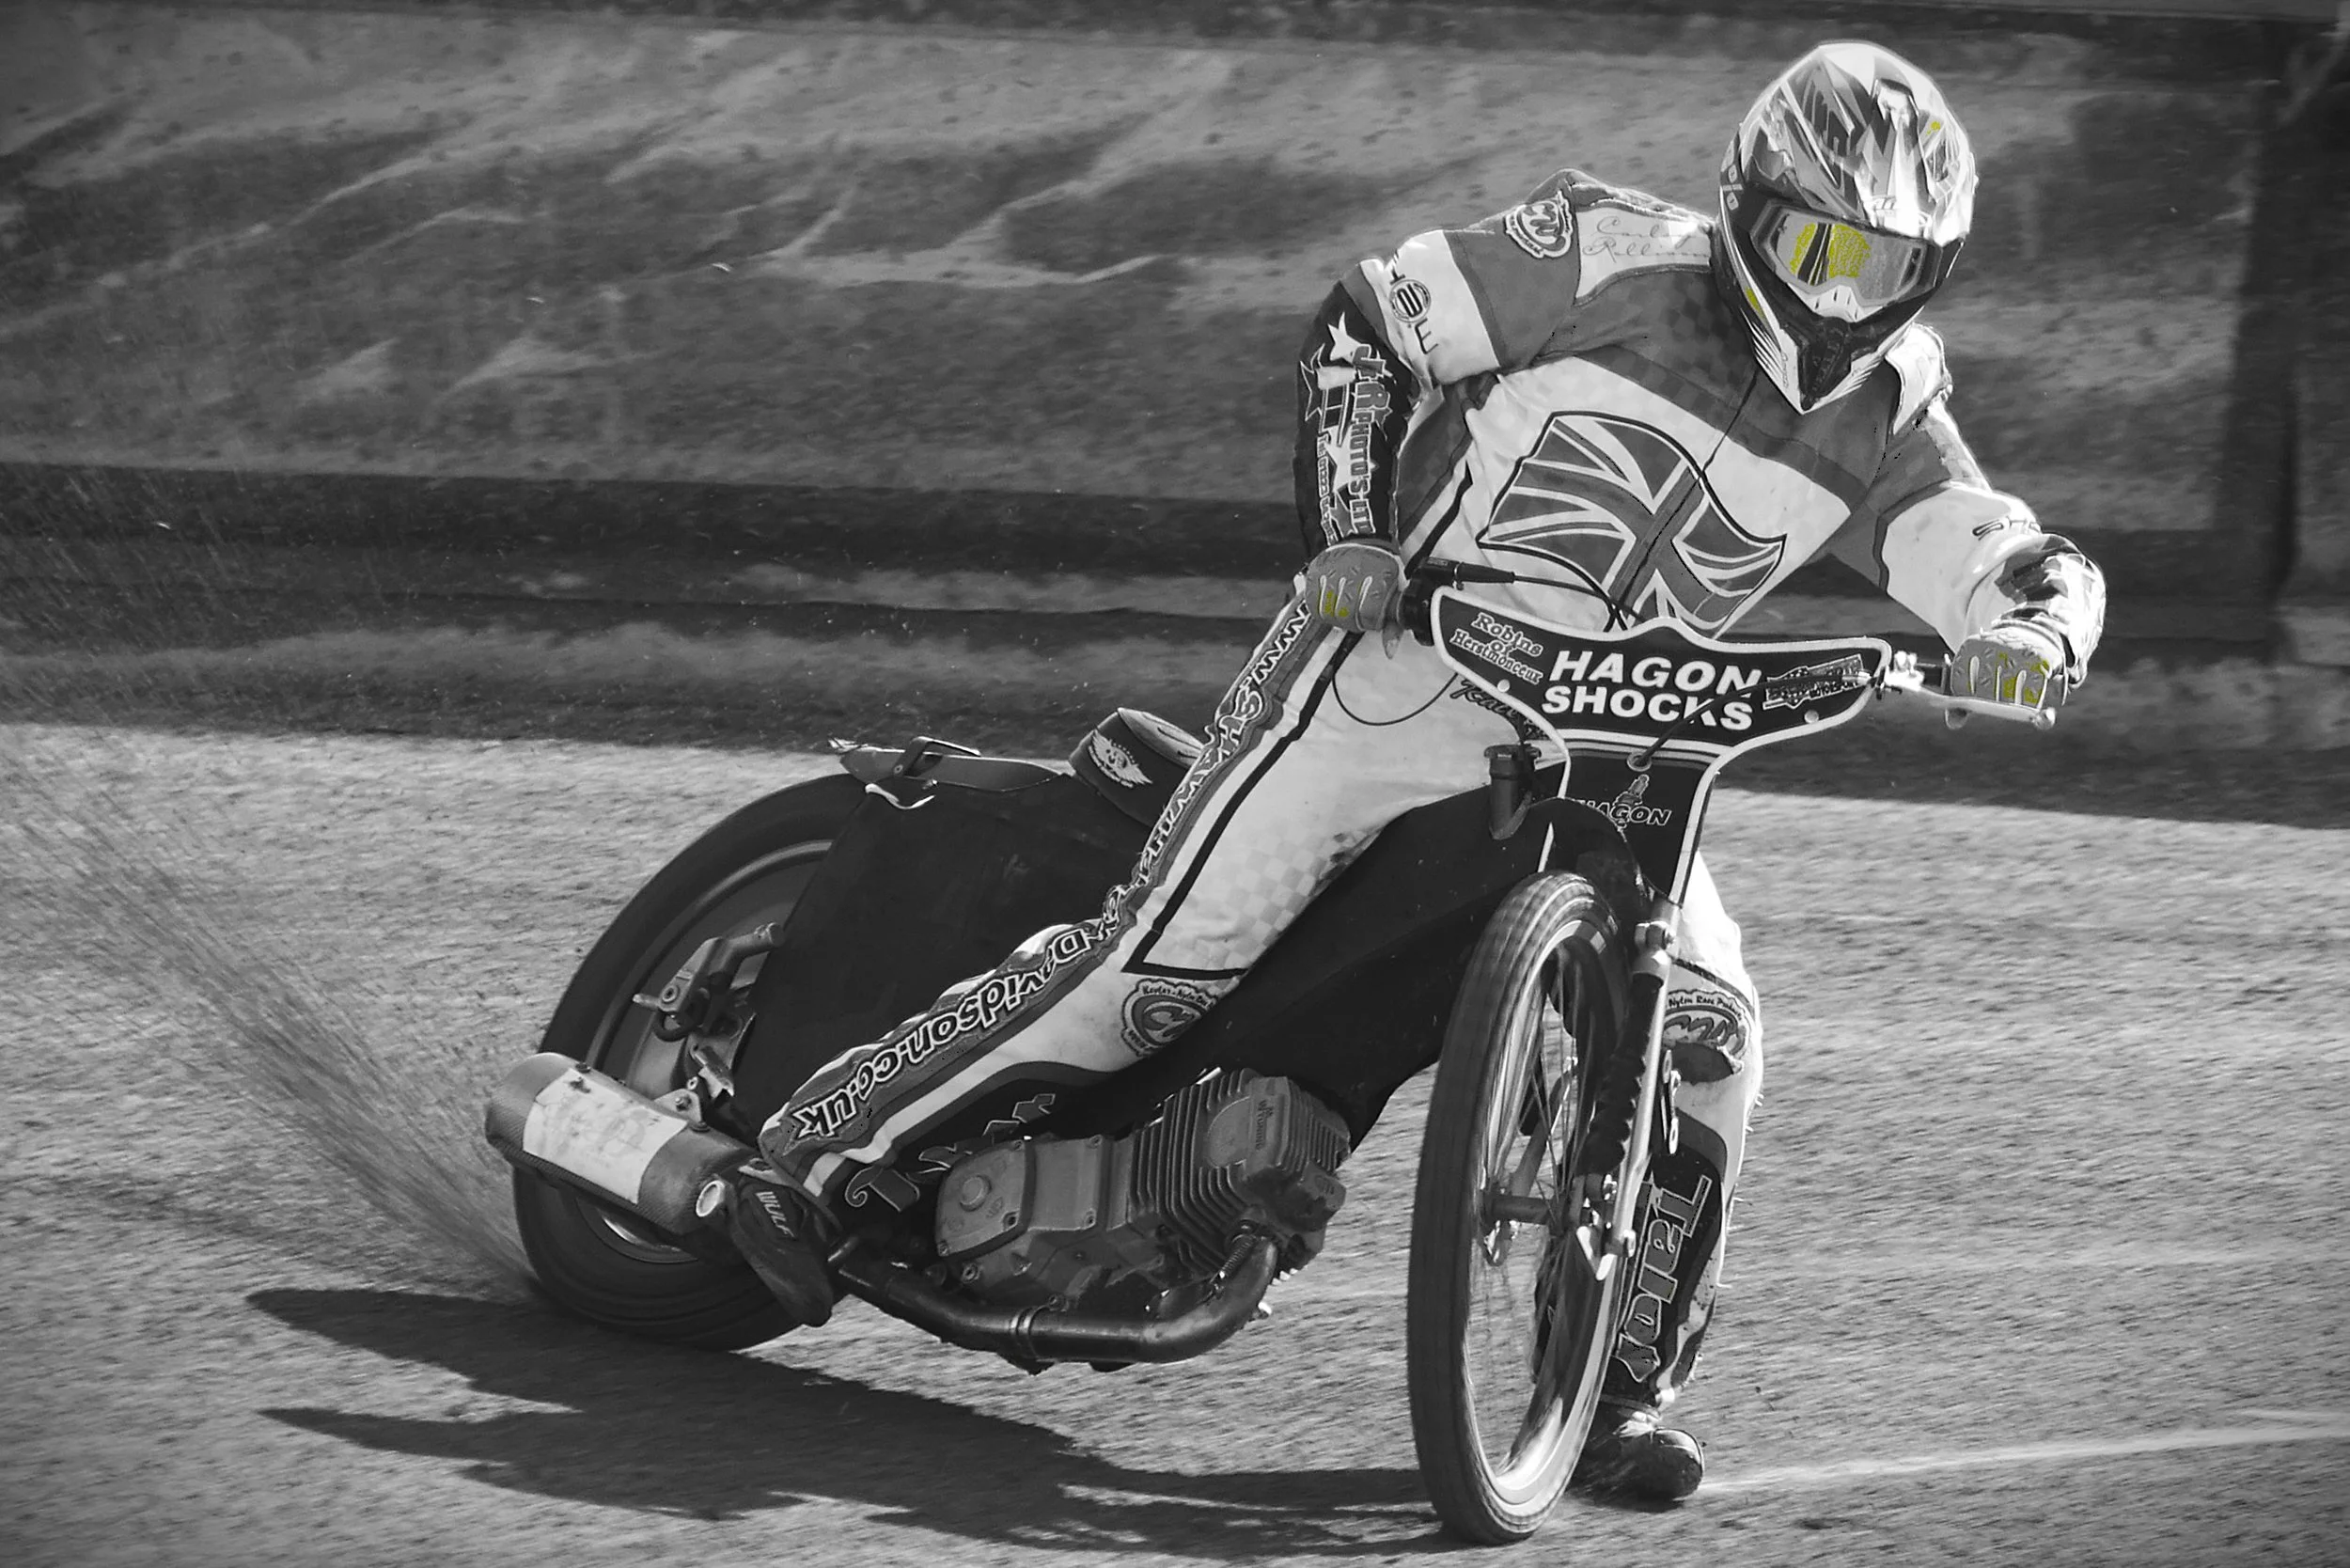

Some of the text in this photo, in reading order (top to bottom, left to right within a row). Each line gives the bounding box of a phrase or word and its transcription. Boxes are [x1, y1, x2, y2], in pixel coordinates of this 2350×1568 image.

[1449, 628, 1544, 685] Herstmonceux
[1471, 612, 1544, 657] Robins
[1489, 640, 1516, 659] of
[1549, 651, 1762, 698] HAGON
[1542, 685, 1753, 730] SHOCKS
